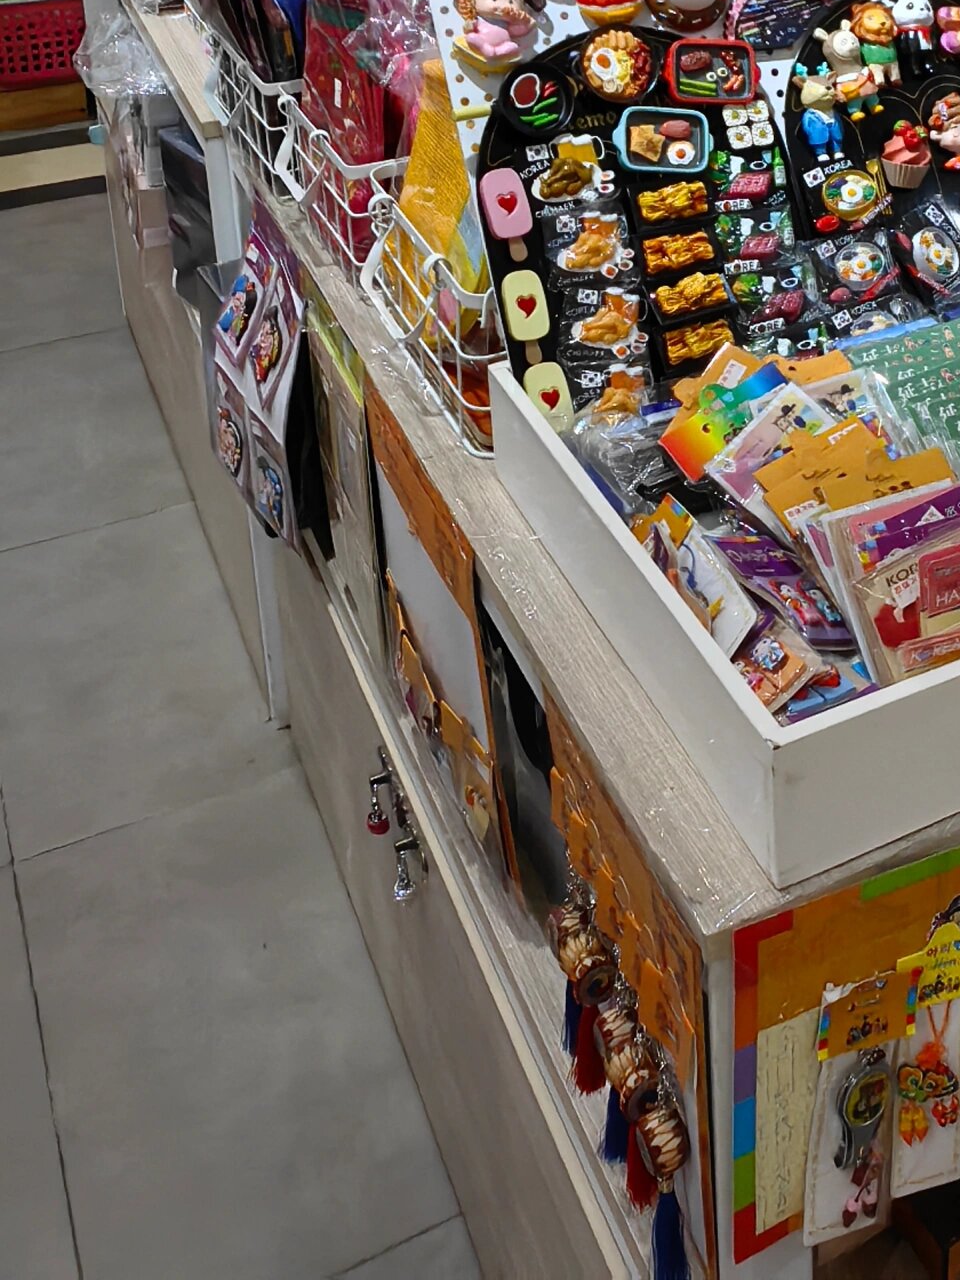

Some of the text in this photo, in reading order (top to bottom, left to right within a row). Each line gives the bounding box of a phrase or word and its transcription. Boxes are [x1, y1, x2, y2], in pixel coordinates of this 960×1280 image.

[520, 160, 551, 180] KOREA
[823, 159, 854, 175] KOREA
[715, 199, 752, 213] KOREA
[725, 260, 762, 275] KOREA
[750, 318, 786, 335] KOREA
[886, 564, 918, 587] KOR
